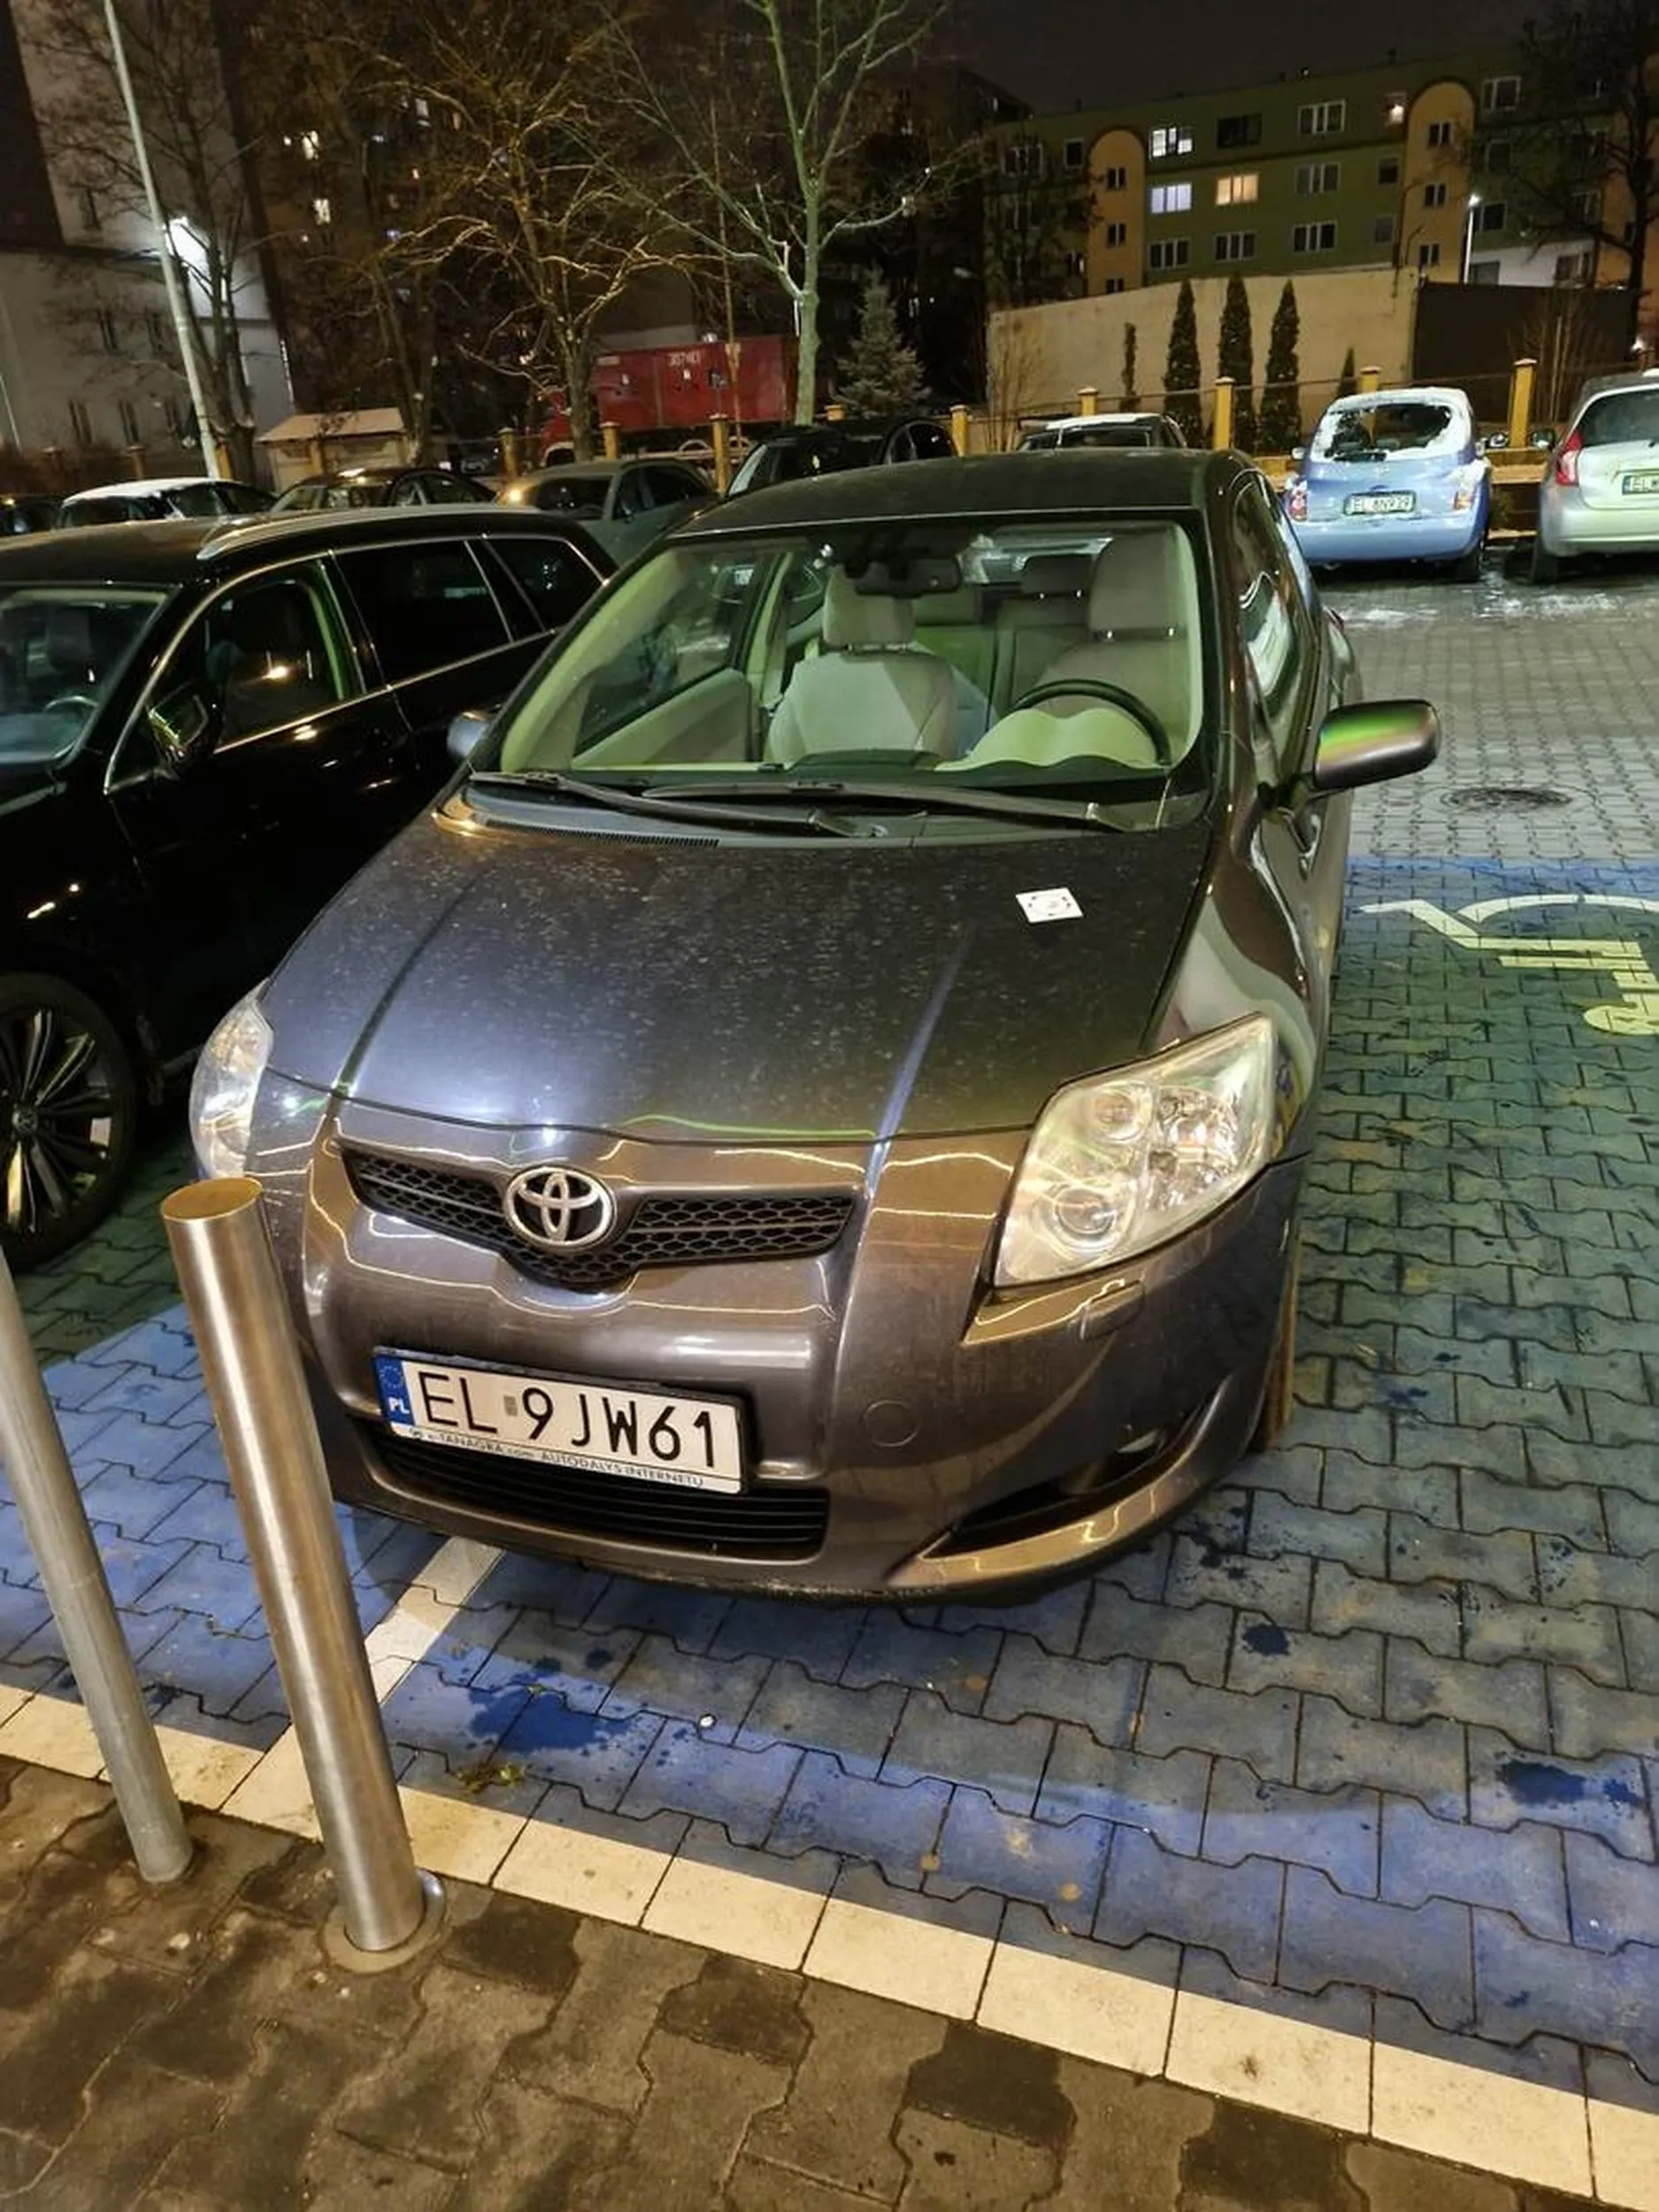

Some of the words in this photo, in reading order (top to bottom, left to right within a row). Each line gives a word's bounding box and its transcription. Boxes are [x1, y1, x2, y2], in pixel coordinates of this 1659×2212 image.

[388, 1396, 410, 1415] PL
[419, 1371, 497, 1434] EL
[521, 1386, 716, 1469] 9JW61
